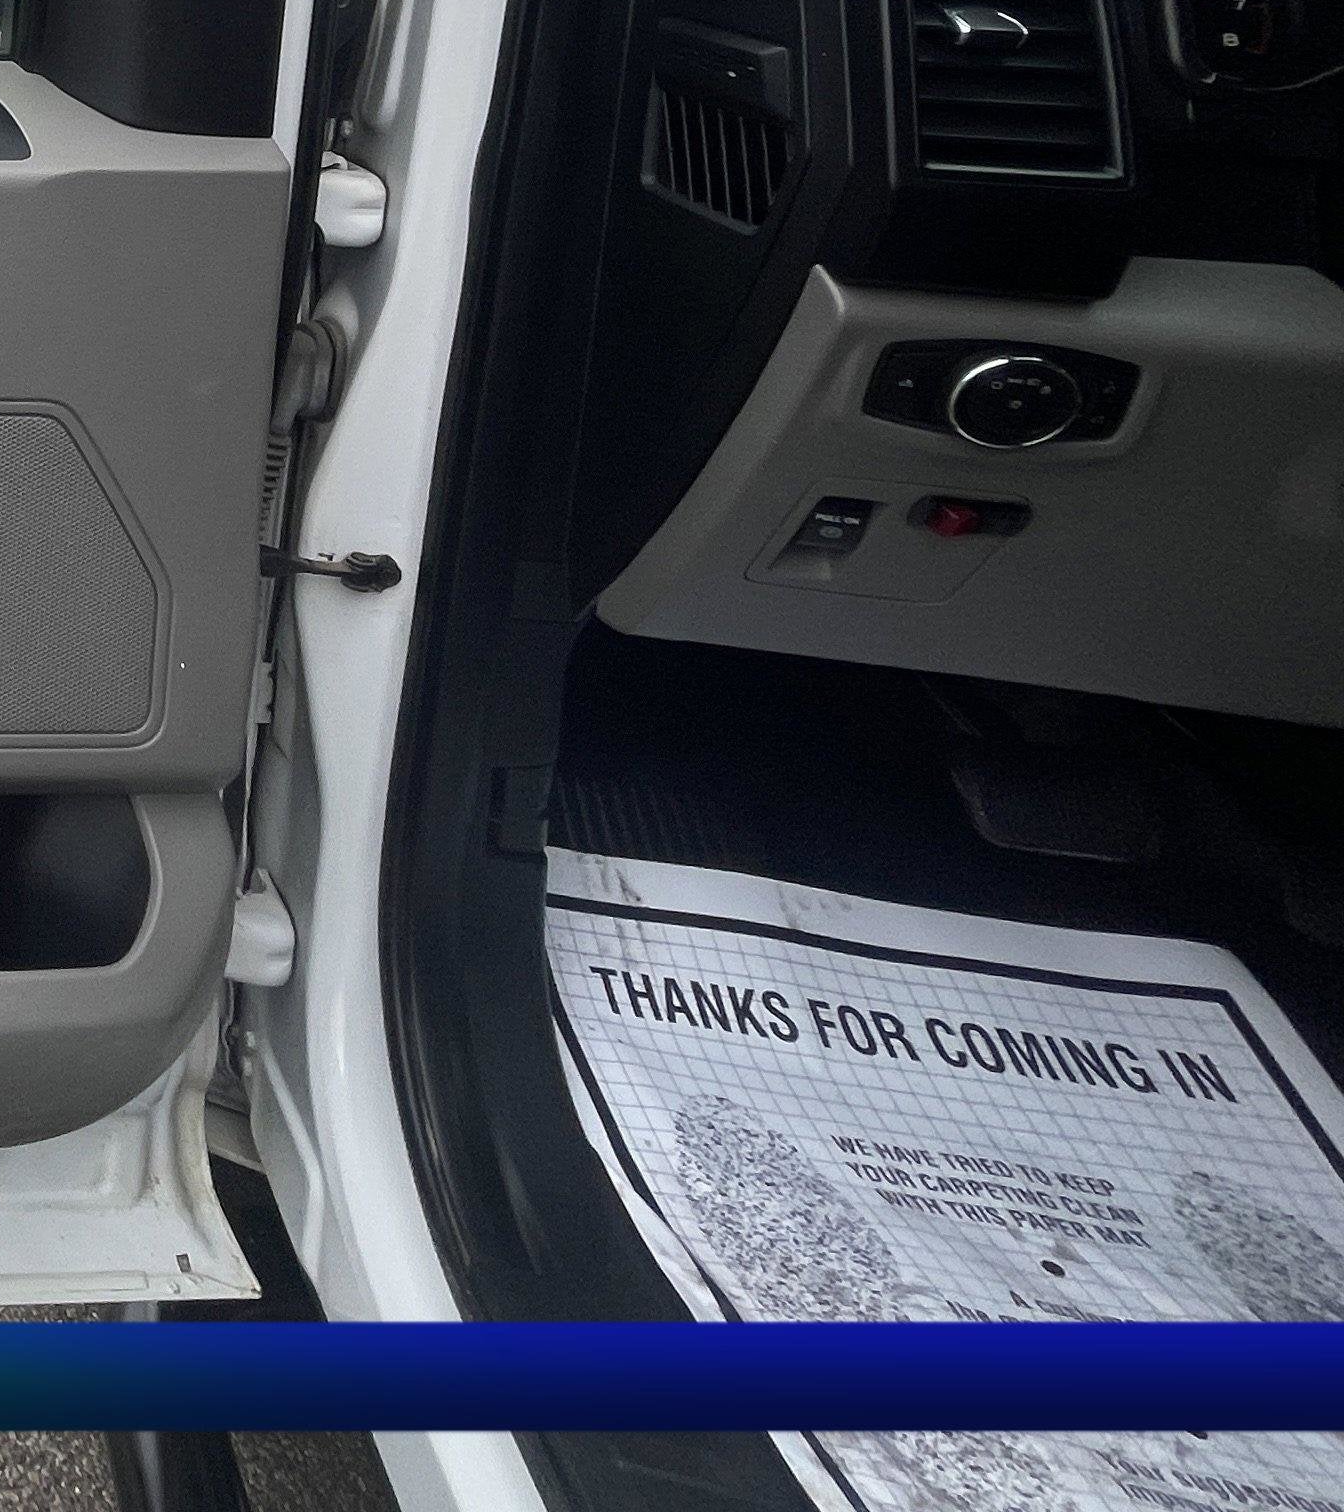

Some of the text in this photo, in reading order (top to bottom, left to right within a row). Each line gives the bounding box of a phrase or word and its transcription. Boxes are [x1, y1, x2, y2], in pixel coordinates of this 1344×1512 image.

[589, 965, 1239, 1104] THANKS FOR COMING IN
[830, 1134, 1115, 1197] WE HAVE TRIED TO KEEP
[845, 1161, 1145, 1226] YOUR CARPETING CLEAN
[876, 1188, 1152, 1249] WITH THIS PAPER MAT
